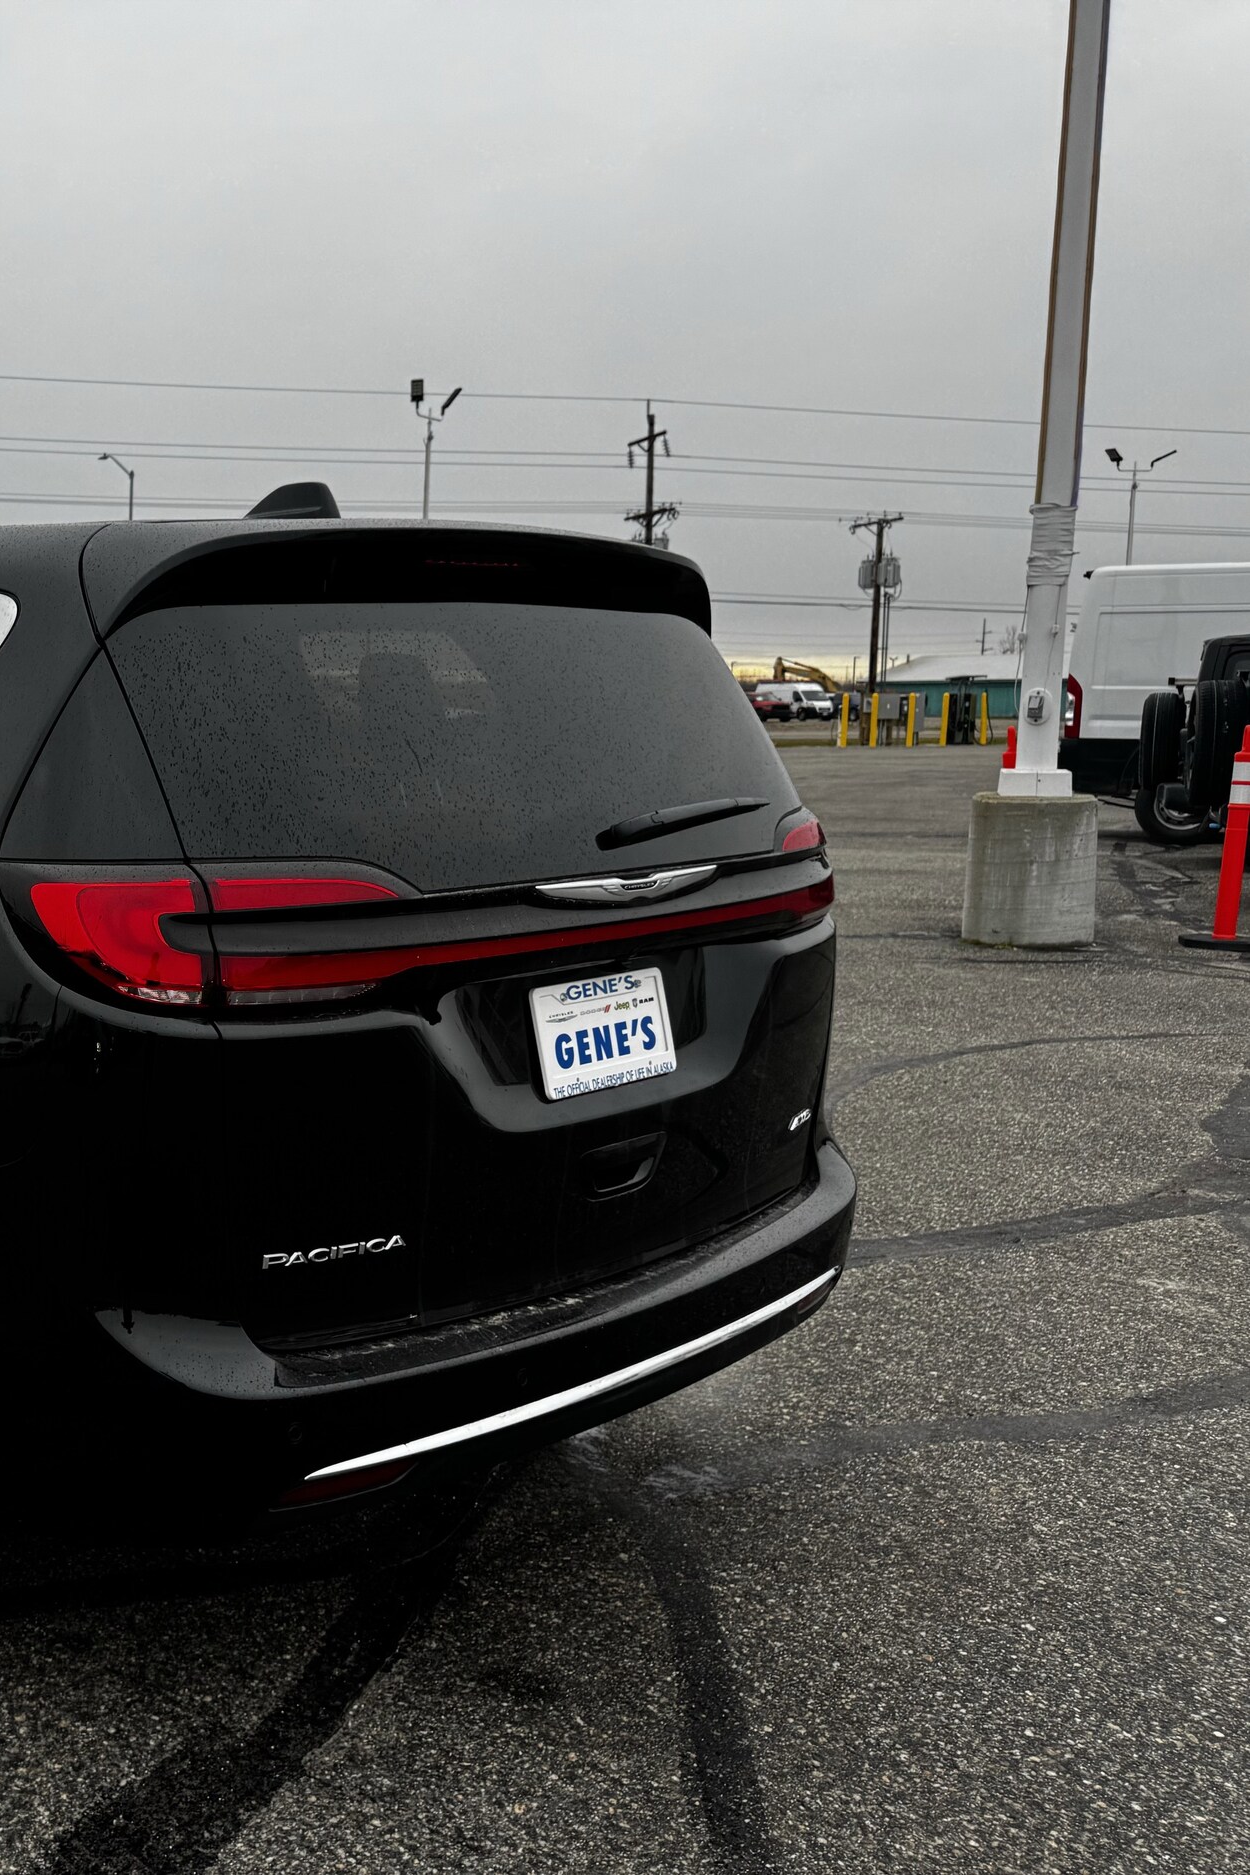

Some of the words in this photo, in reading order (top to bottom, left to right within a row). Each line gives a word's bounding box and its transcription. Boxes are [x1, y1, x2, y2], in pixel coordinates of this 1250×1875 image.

[567, 975, 635, 1000] GENE'S
[614, 1001, 630, 1011] Jeep
[555, 1016, 656, 1069] GENE'S
[553, 1086, 566, 1098] THE
[566, 1080, 592, 1096] OFFICIAL
[592, 1072, 625, 1090] DEALERSHIP
[626, 1070, 634, 1082] OF
[635, 1067, 645, 1079] LIFE
[645, 1065, 652, 1077] IN
[653, 1061, 673, 1075] ALASKA
[262, 1235, 406, 1270] PACIFICA
